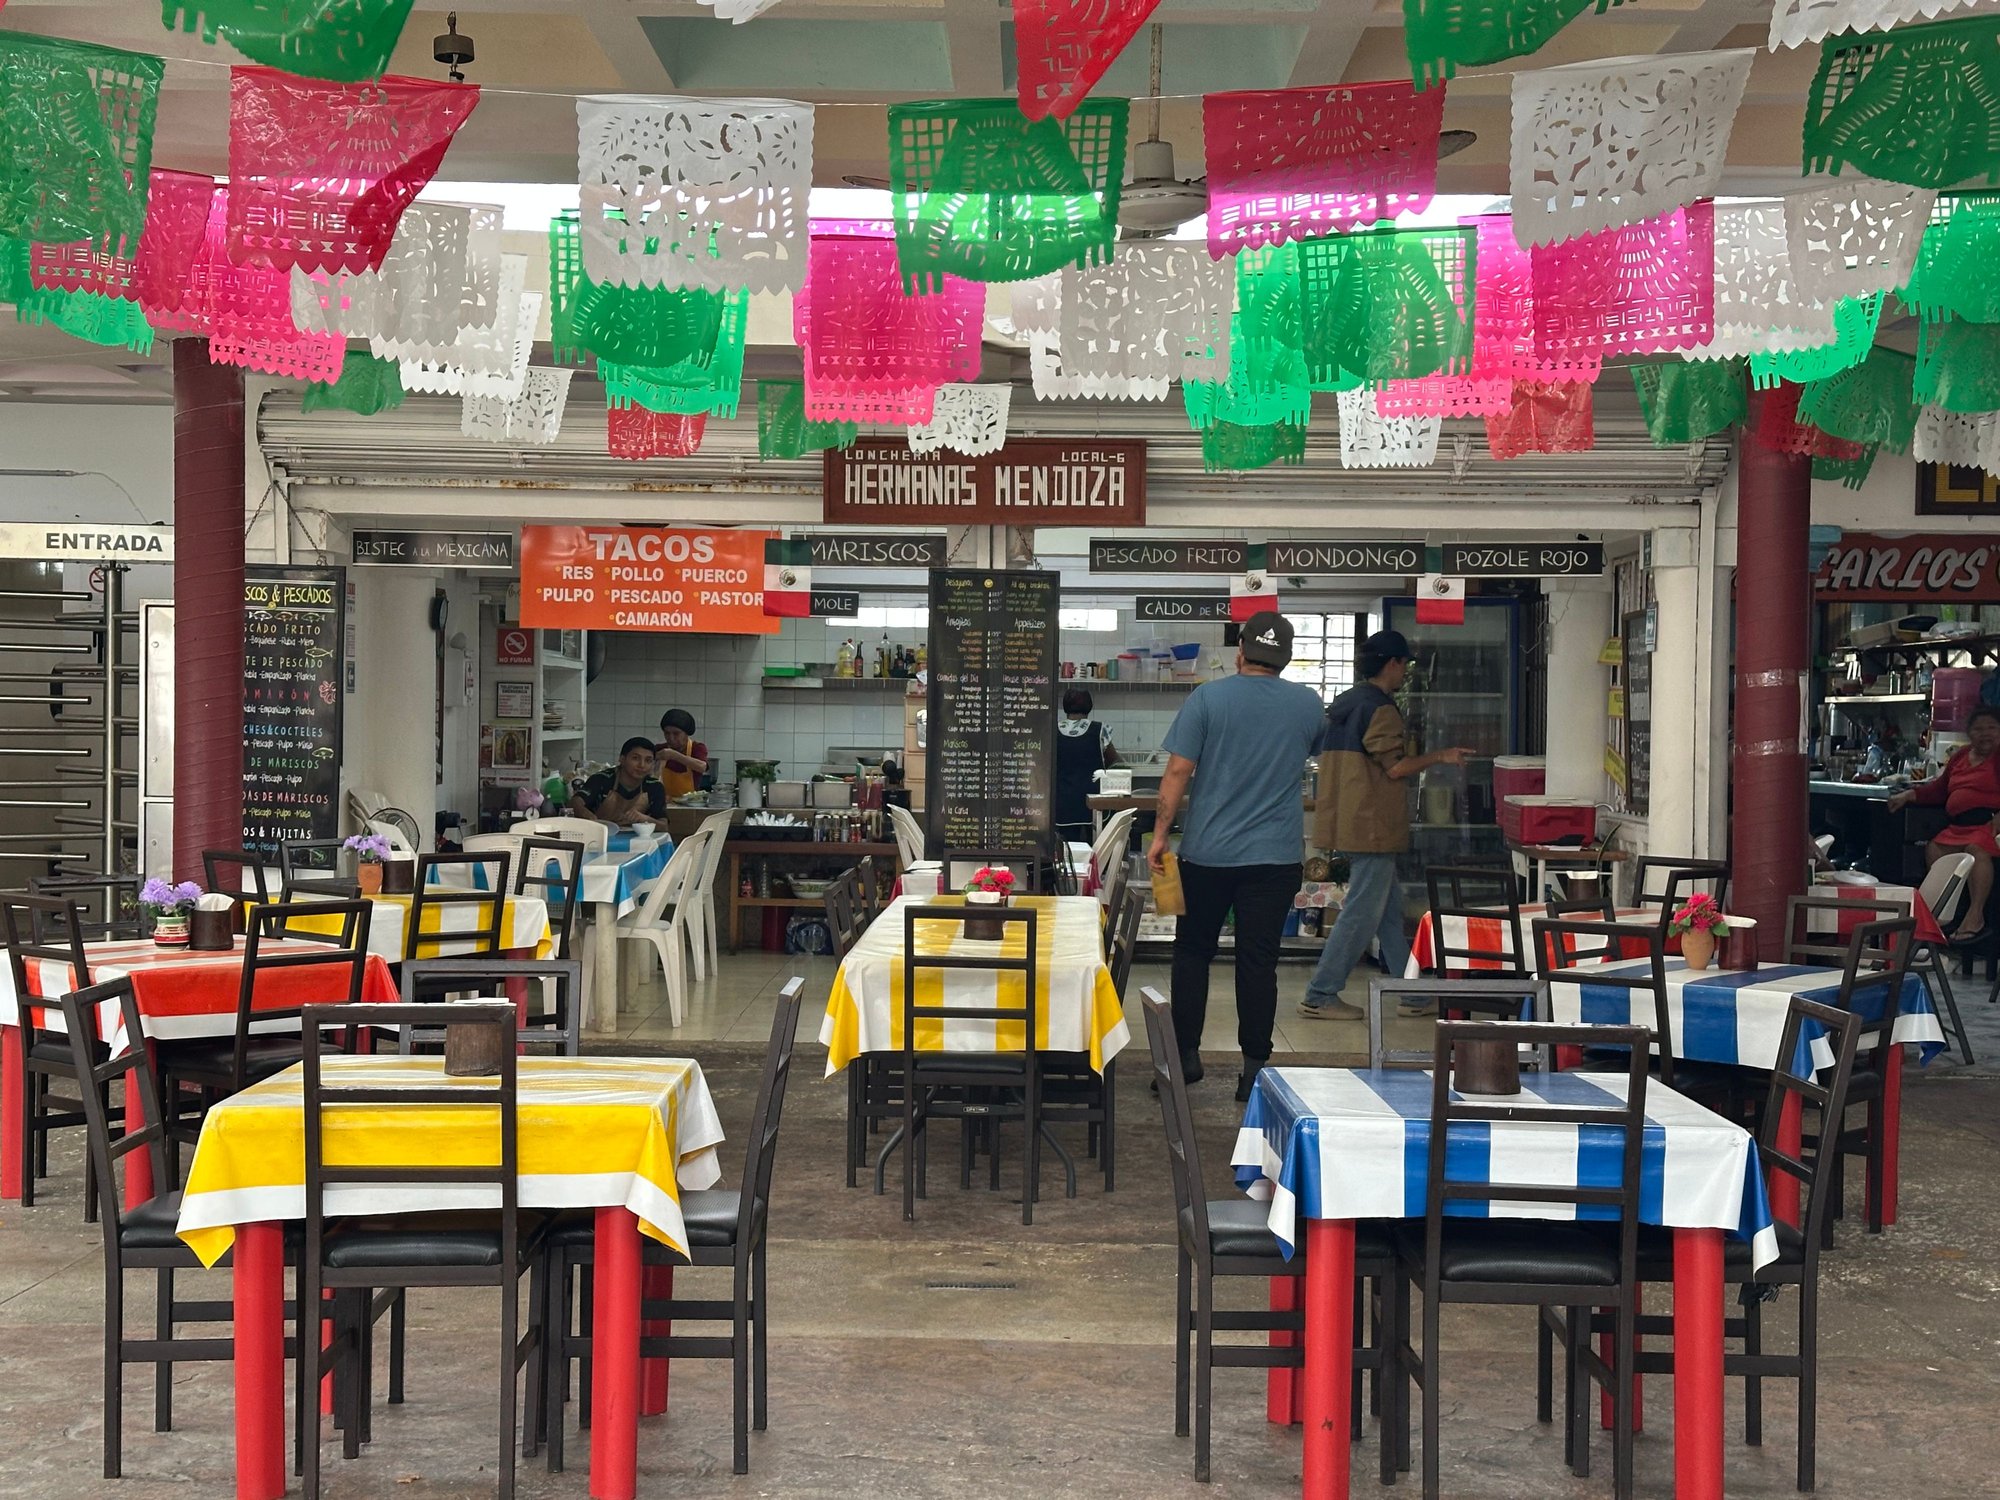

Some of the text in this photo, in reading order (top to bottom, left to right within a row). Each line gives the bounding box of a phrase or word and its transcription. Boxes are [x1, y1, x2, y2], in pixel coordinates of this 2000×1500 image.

[845, 464, 1125, 507] HERMANAS MENDOZA
[46, 533, 163, 552] ENTRADA
[356, 541, 508, 558] BISTEC A LA MEXICANA
[589, 534, 715, 563] TACOS
[812, 539, 931, 562] MARISCOS
[1096, 546, 1241, 567] PESCADO FRITO
[1275, 547, 1417, 571] MONDONGO
[1456, 549, 1588, 572] POZOLE ROJO
[563, 566, 748, 584] RES POLLO PUERCO
[272, 584, 280, 602] &
[284, 586, 331, 606] PESCADOS
[543, 588, 764, 607] PULPO PESCADO PASTOR
[815, 597, 852, 611] MOLE
[1145, 601, 1192, 616] CALDO
[615, 609, 693, 627] CAMARÓN
[285, 624, 321, 635] FRITO
[262, 656, 273, 666] DE
[280, 657, 323, 669] PESCADO
[251, 757, 319, 769] DE MARISCOS
[262, 791, 273, 801] DE
[277, 792, 328, 804] MARISCOS
[259, 826, 265, 837] &
[272, 827, 311, 841] FAJITAS
